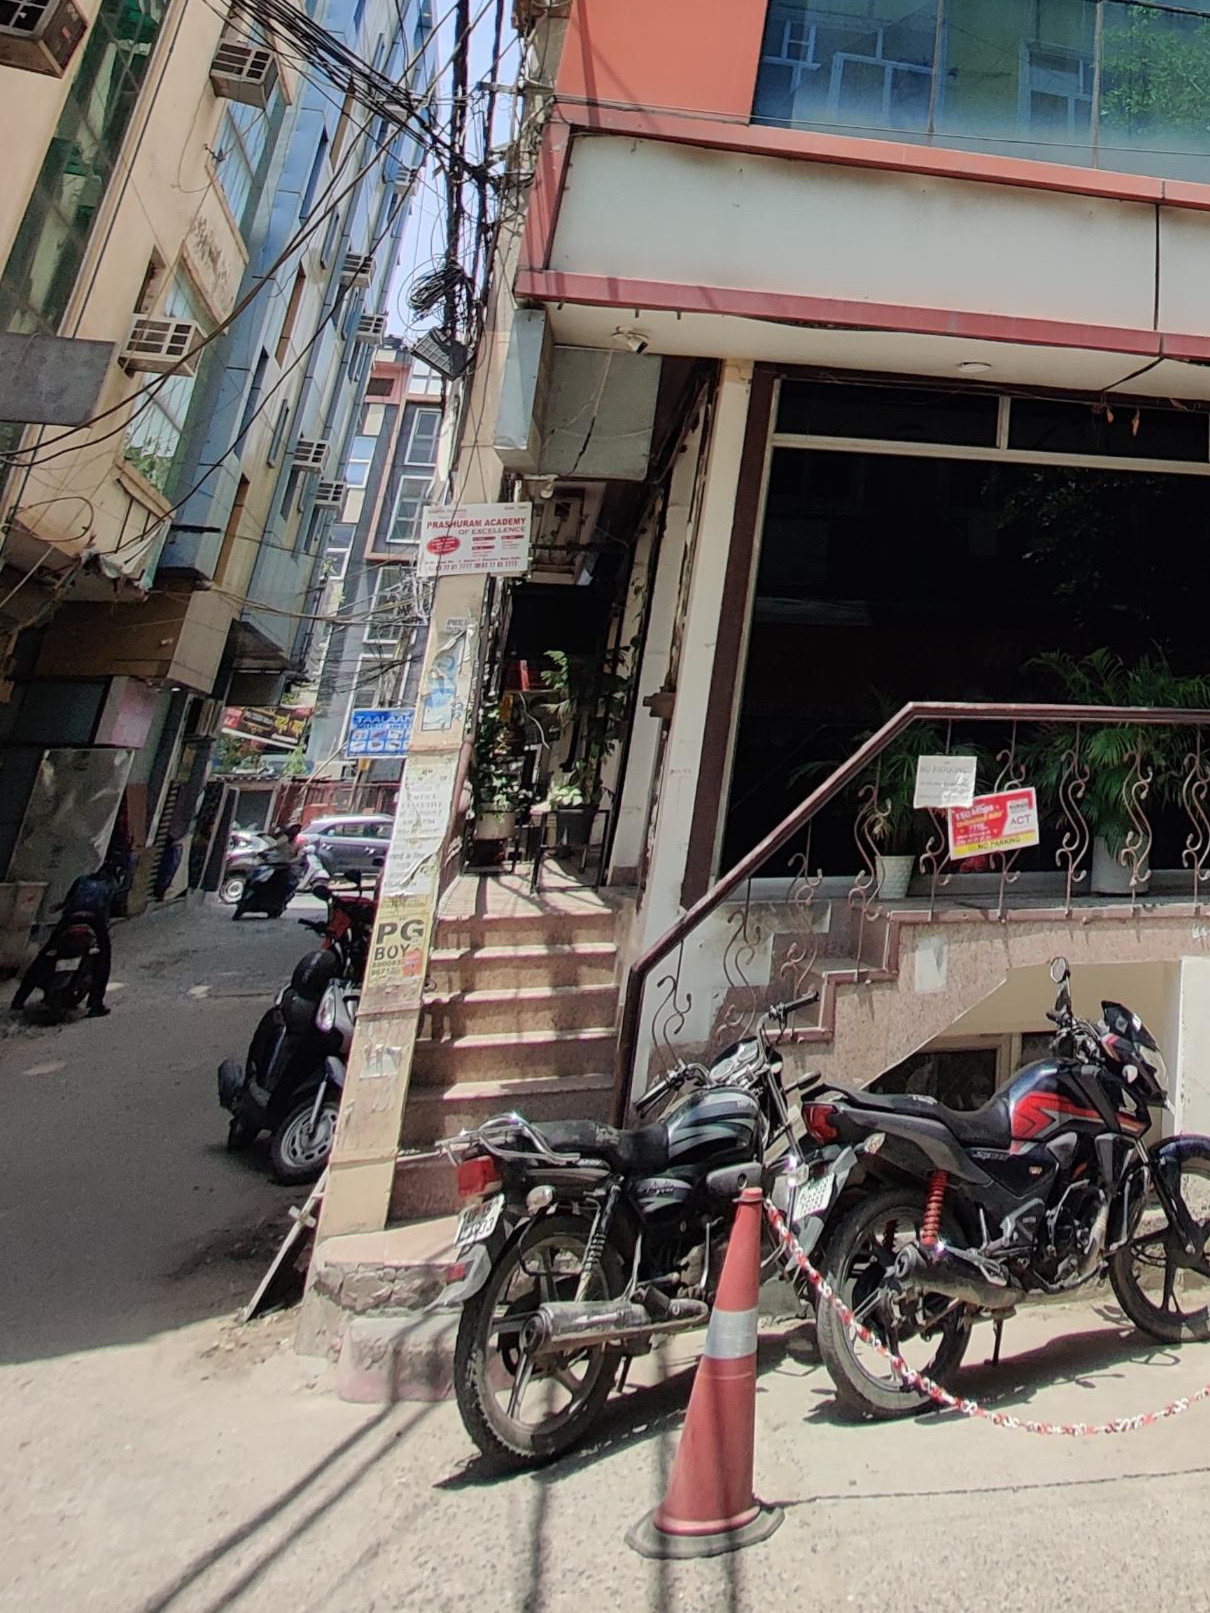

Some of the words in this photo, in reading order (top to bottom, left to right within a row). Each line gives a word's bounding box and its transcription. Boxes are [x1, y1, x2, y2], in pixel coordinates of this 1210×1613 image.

[427, 520, 482, 529] PRASHURAM
[484, 517, 526, 526] ACADEMY
[472, 527, 526, 535] EXCELLENCE
[1010, 814, 1032, 826] ACT
[977, 842, 989, 850] NO
[989, 836, 1021, 849] PARKING
[376, 919, 425, 945] PG
